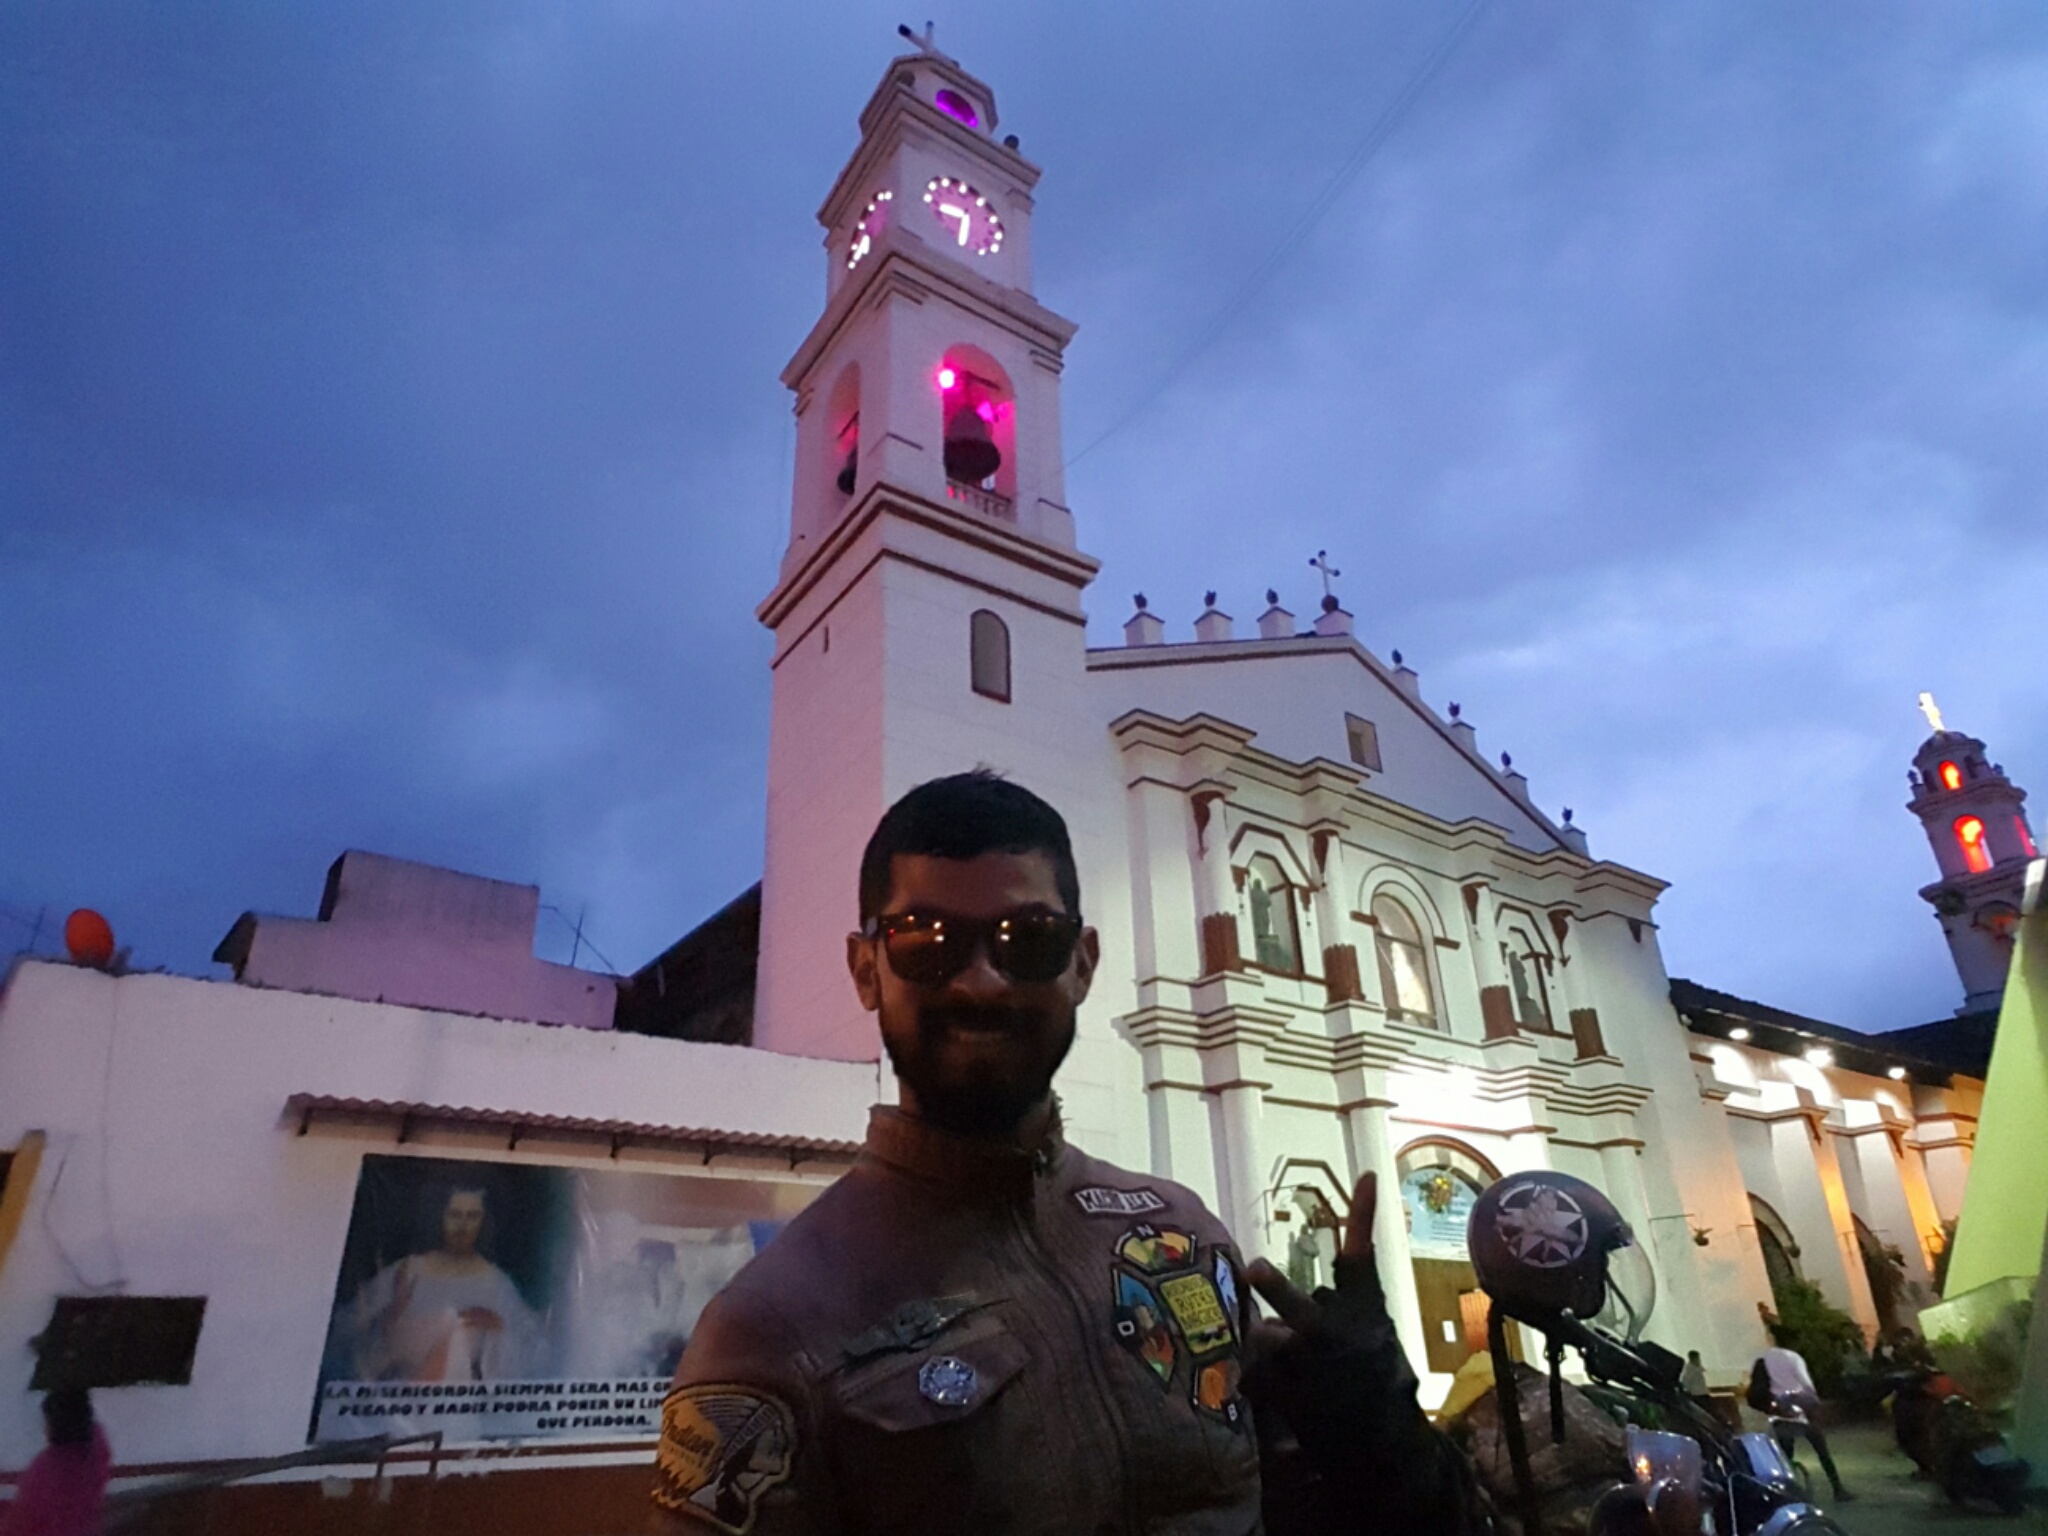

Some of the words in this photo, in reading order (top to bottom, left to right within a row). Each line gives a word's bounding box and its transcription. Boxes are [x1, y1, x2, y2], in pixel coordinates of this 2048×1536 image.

[1136, 1224, 1155, 1236] N
[325, 1386, 350, 1398] LA
[356, 1385, 487, 1398] MISERICORDIA
[494, 1383, 564, 1396] SIEMPRE
[569, 1382, 610, 1394] SERA
[615, 1381, 649, 1393] MAS
[338, 1403, 412, 1417] PECADO
[416, 1403, 427, 1415] Y
[433, 1402, 488, 1415] NADIE
[492, 1401, 551, 1413] PODRA
[556, 1399, 610, 1411] PONER
[614, 1398, 635, 1409] UN
[537, 1417, 568, 1429] QUE
